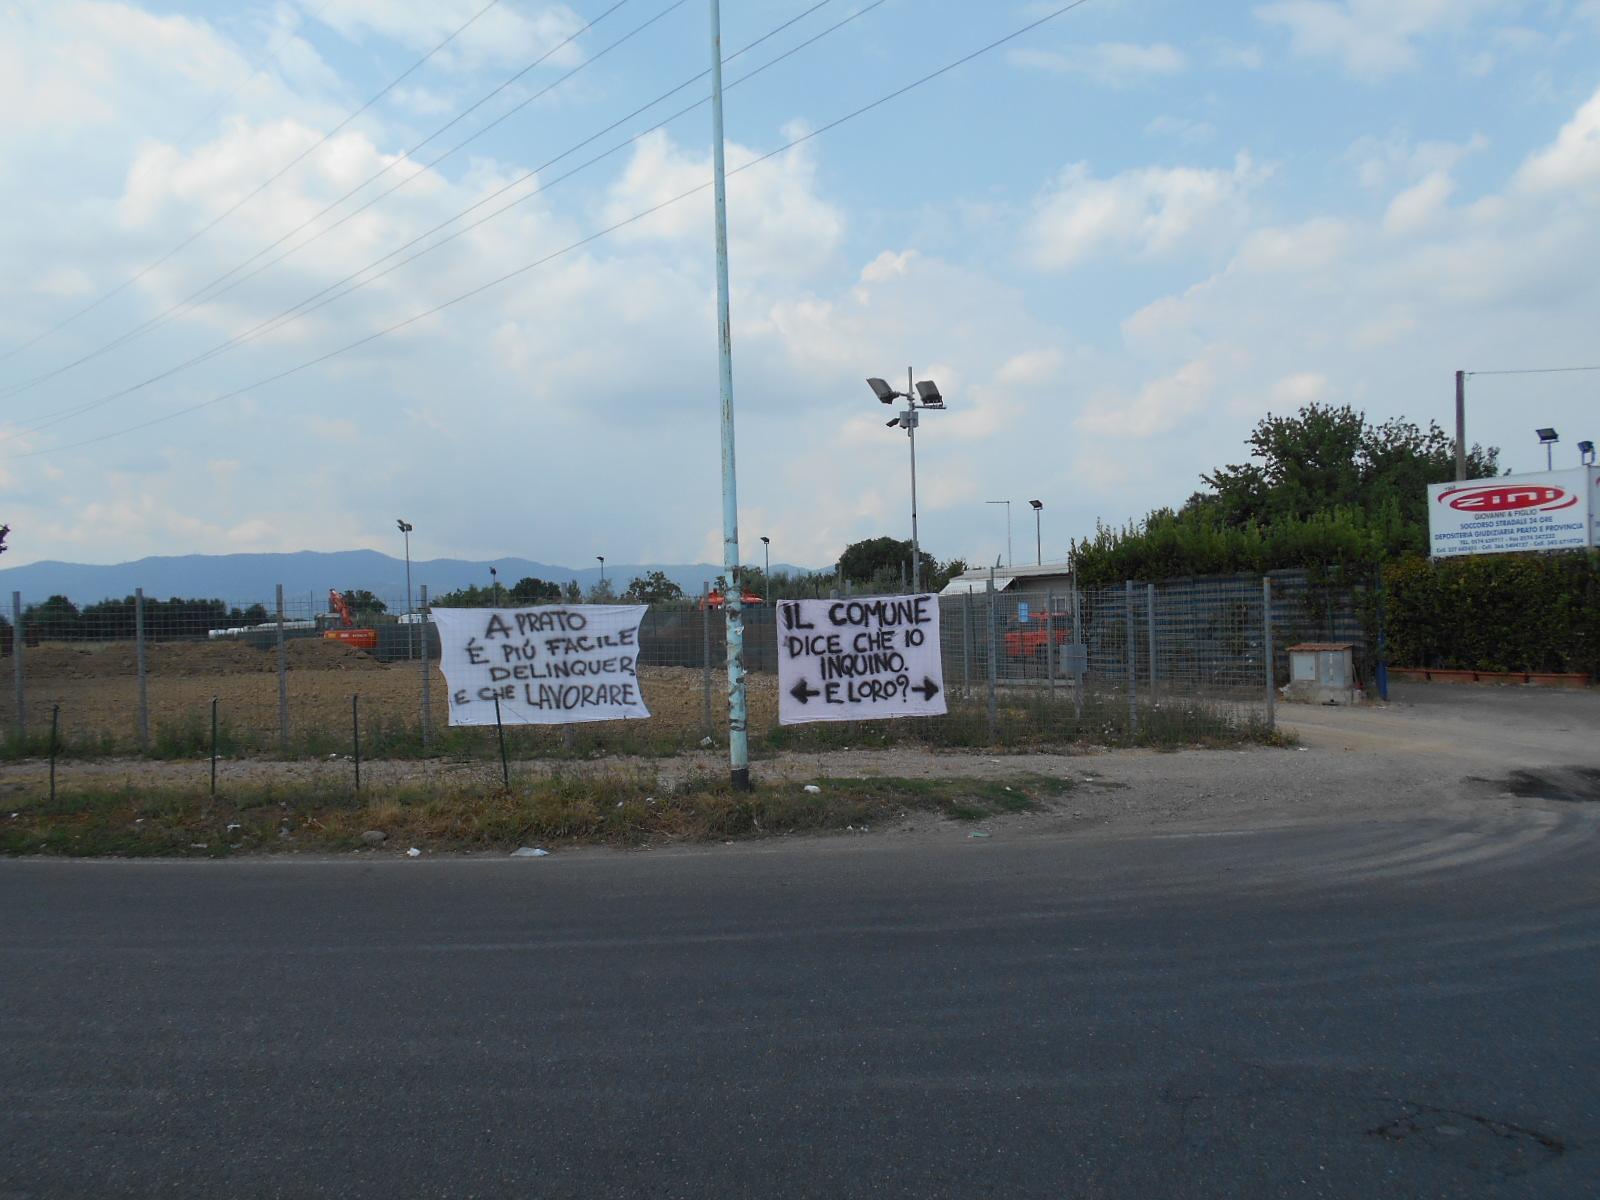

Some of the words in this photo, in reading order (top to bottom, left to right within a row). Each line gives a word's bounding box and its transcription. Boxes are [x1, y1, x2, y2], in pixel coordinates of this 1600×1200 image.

[1460, 521, 1494, 529] SOCCORSO
[1495, 518, 1527, 527] STRADALE
[1474, 511, 1506, 520] GIOVANNI
[1514, 509, 1537, 517] FIGLIO
[1434, 531, 1473, 540] DEPOSITERIA
[1474, 528, 1515, 537] GIUDIZIARIA
[1545, 523, 1584, 531] PROVINCIA
[484, 614, 513, 639] A
[514, 610, 587, 636] PRATO
[782, 602, 814, 630] IL
[828, 595, 931, 628] COMUNE
[544, 626, 638, 656] FACILE
[788, 635, 843, 659] DICE
[853, 629, 896, 653] CHE
[905, 628, 924, 648] IO
[489, 656, 636, 682] DELINQUER
[820, 652, 910, 680] INQUINO.
[454, 689, 470, 705] E
[477, 685, 515, 701] CHE
[525, 683, 638, 710] LAVORARE
[825, 682, 844, 704] E
[848, 674, 910, 704] LORO?
